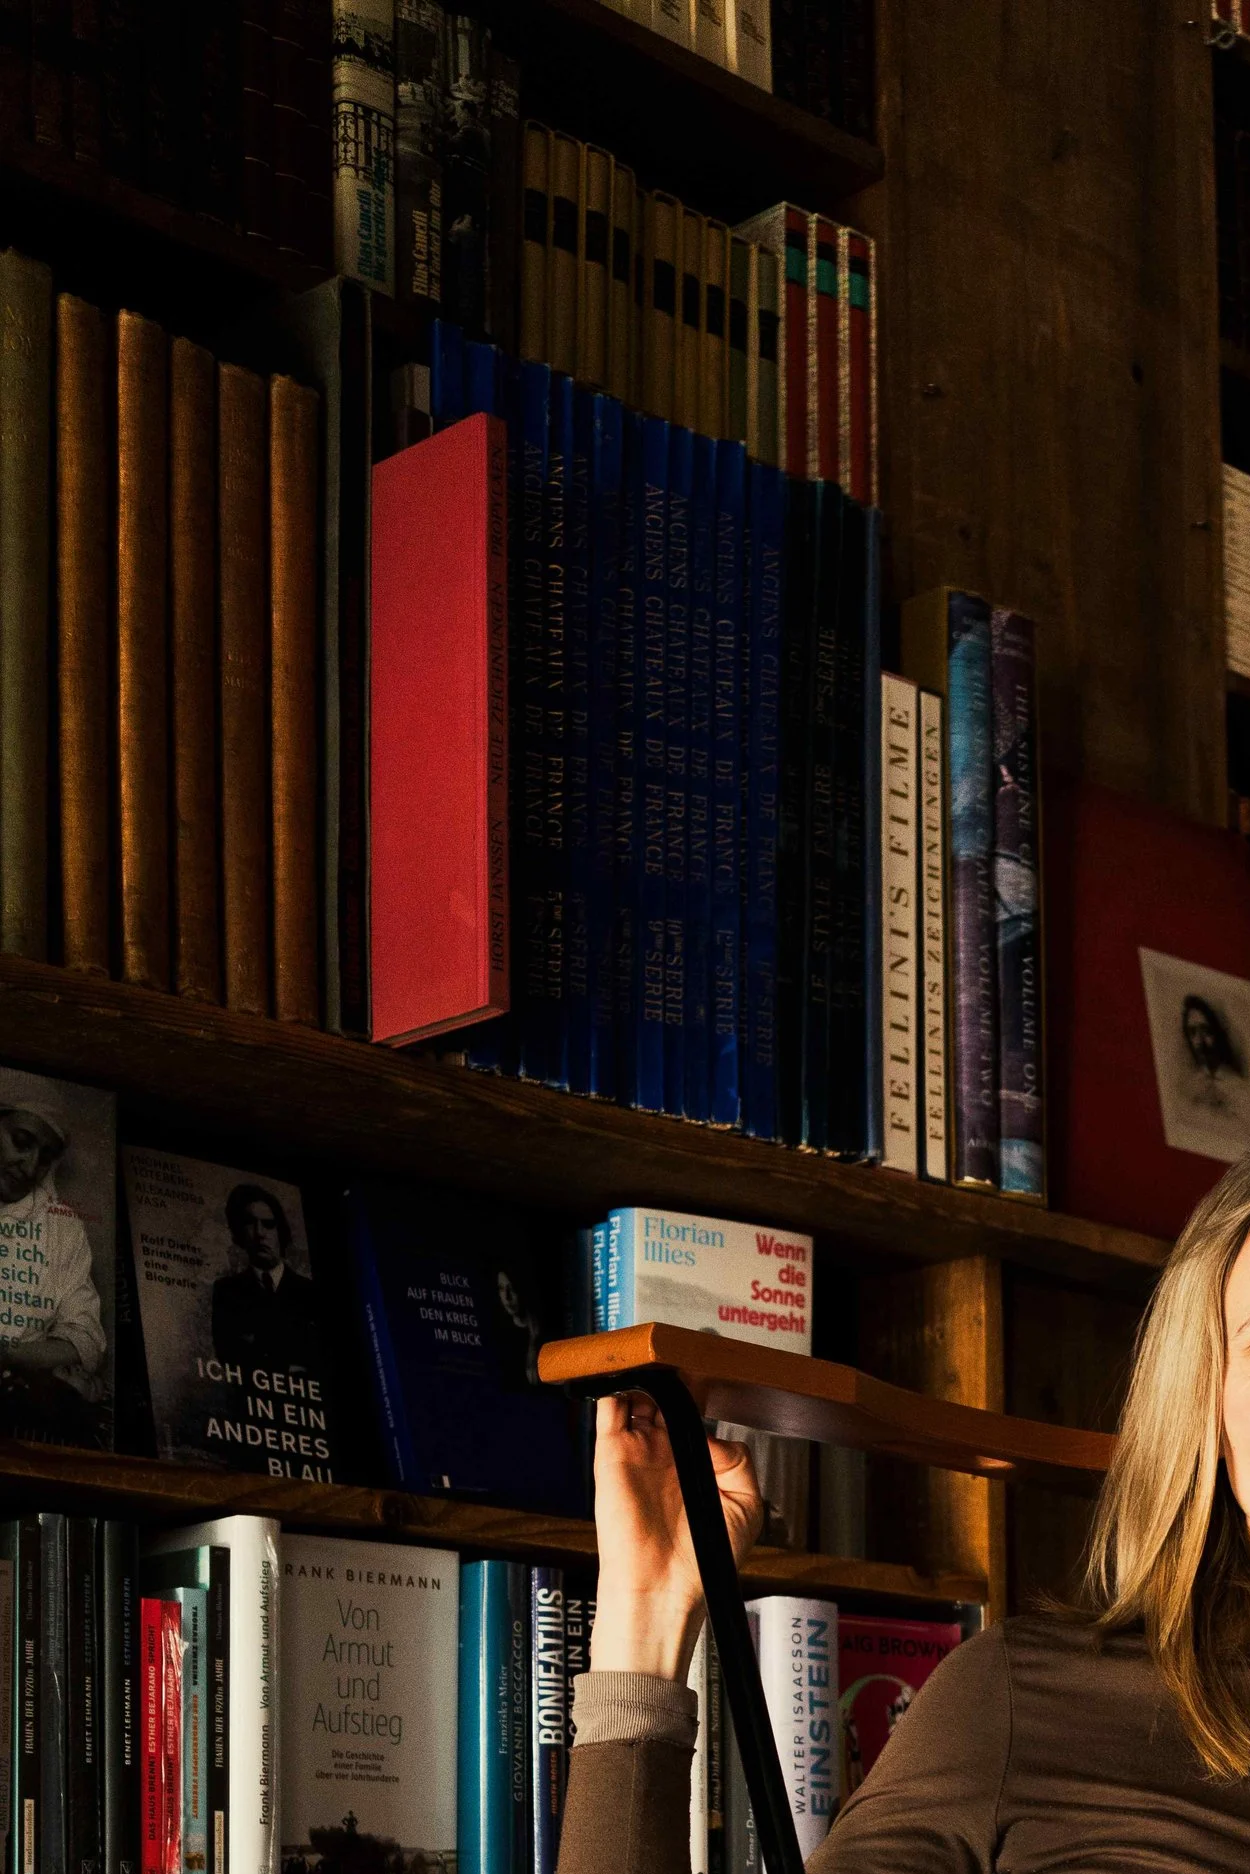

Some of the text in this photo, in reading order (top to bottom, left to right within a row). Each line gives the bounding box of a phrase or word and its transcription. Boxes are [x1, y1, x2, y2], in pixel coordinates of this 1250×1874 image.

[644, 482, 665, 1022] ANCIENS CHATEAUX DE FRANCE SERIE
[493, 820, 504, 972] HORST JANSSEN
[890, 707, 910, 1133] FELLINI'S FILME
[1020, 956, 1038, 1114] VOLUME ONE
[643, 1217, 724, 1249] Florian
[756, 1232, 806, 1262] Wenn
[643, 1240, 695, 1267] Illies
[440, 1272, 470, 1289] BLICK
[778, 1263, 806, 1287] die
[407, 1286, 474, 1307] AUF FRAUEN
[751, 1281, 805, 1309] Sonne
[420, 1307, 478, 1328] DEN KRIEG
[718, 1303, 806, 1336] untergeht
[195, 1357, 322, 1402] ICH GEHE
[247, 1396, 325, 1430] IN EIN
[206, 1418, 329, 1457] ANDERES
[337, 1599, 379, 1631] Von
[322, 1634, 394, 1668] Armut
[536, 1587, 563, 1746] BONIFATIUS
[336, 1672, 379, 1701] und
[312, 1703, 402, 1746] Aufstieg
[792, 1617, 805, 1815] WALTER ISAACSON
[807, 1619, 832, 1817] EINSTEIN
[345, 1751, 384, 1762] Geschichte
[351, 1772, 399, 1783] Jahrhunderte
